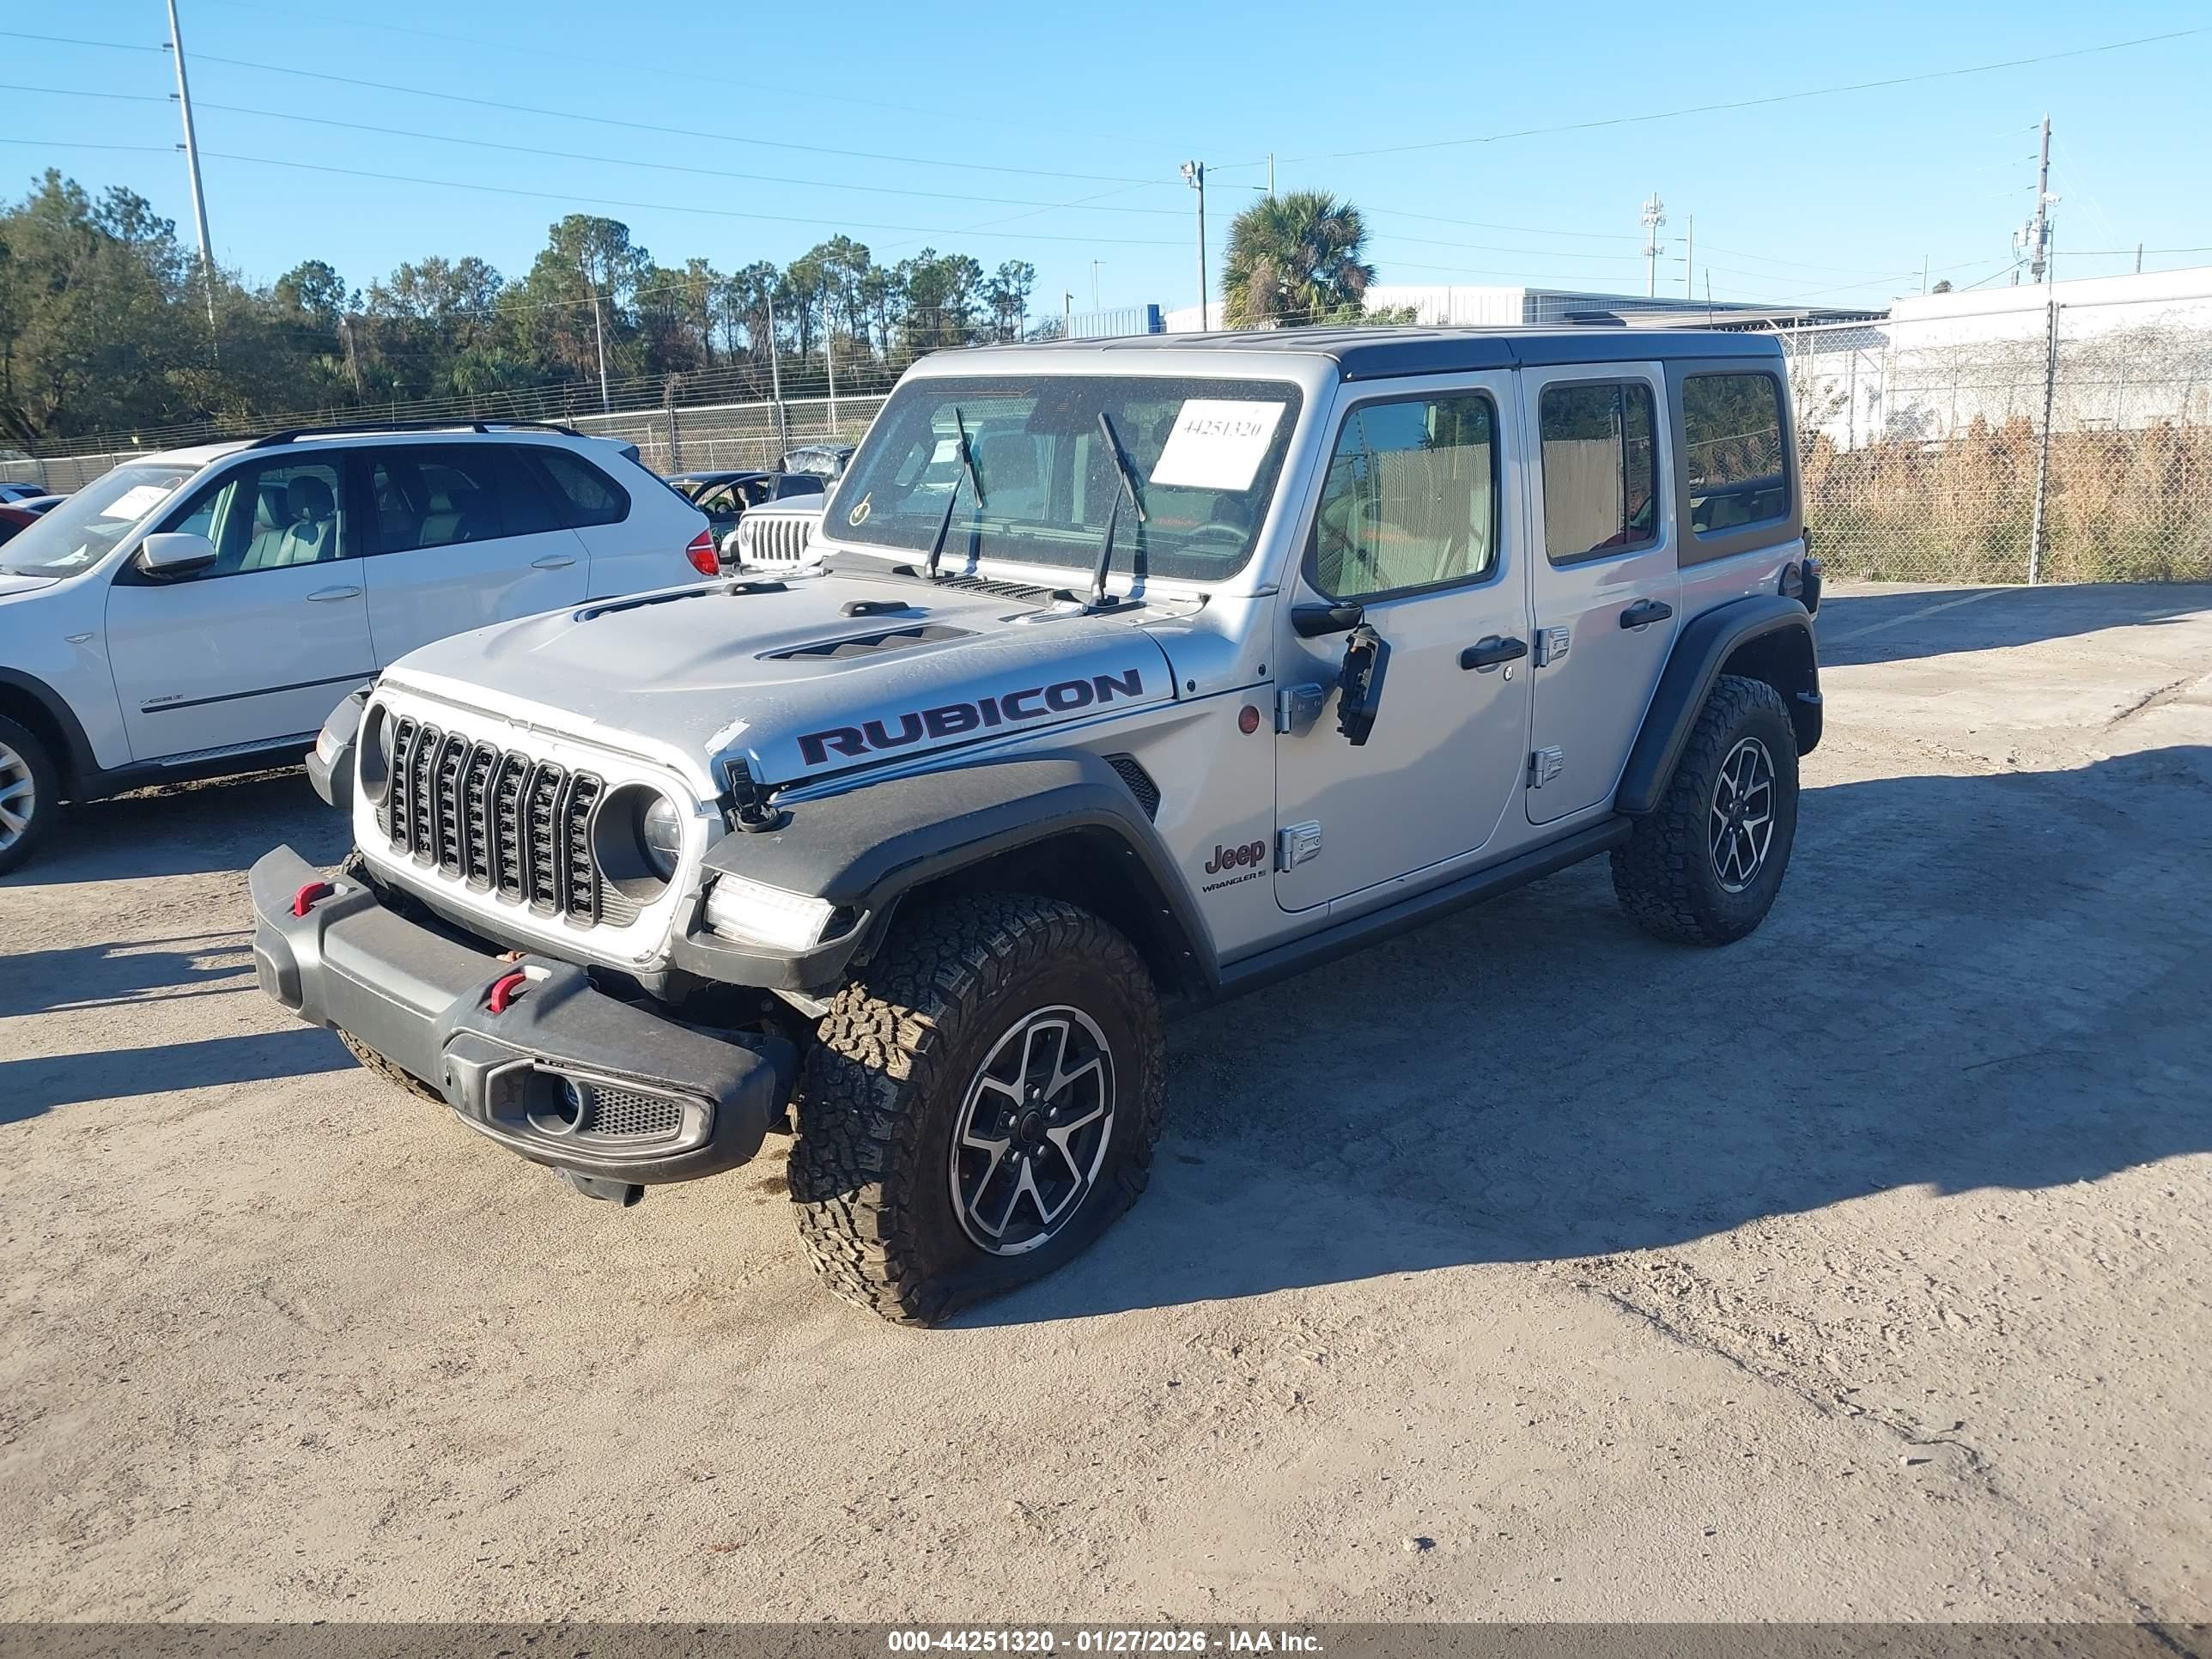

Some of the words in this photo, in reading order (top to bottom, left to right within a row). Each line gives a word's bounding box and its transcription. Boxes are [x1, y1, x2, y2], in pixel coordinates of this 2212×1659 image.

[1183, 419, 1262, 436] 44251320
[796, 668, 1145, 767] RUBICON
[1205, 840, 1266, 874] Jeep
[1201, 872, 1257, 893] WRANGLER
